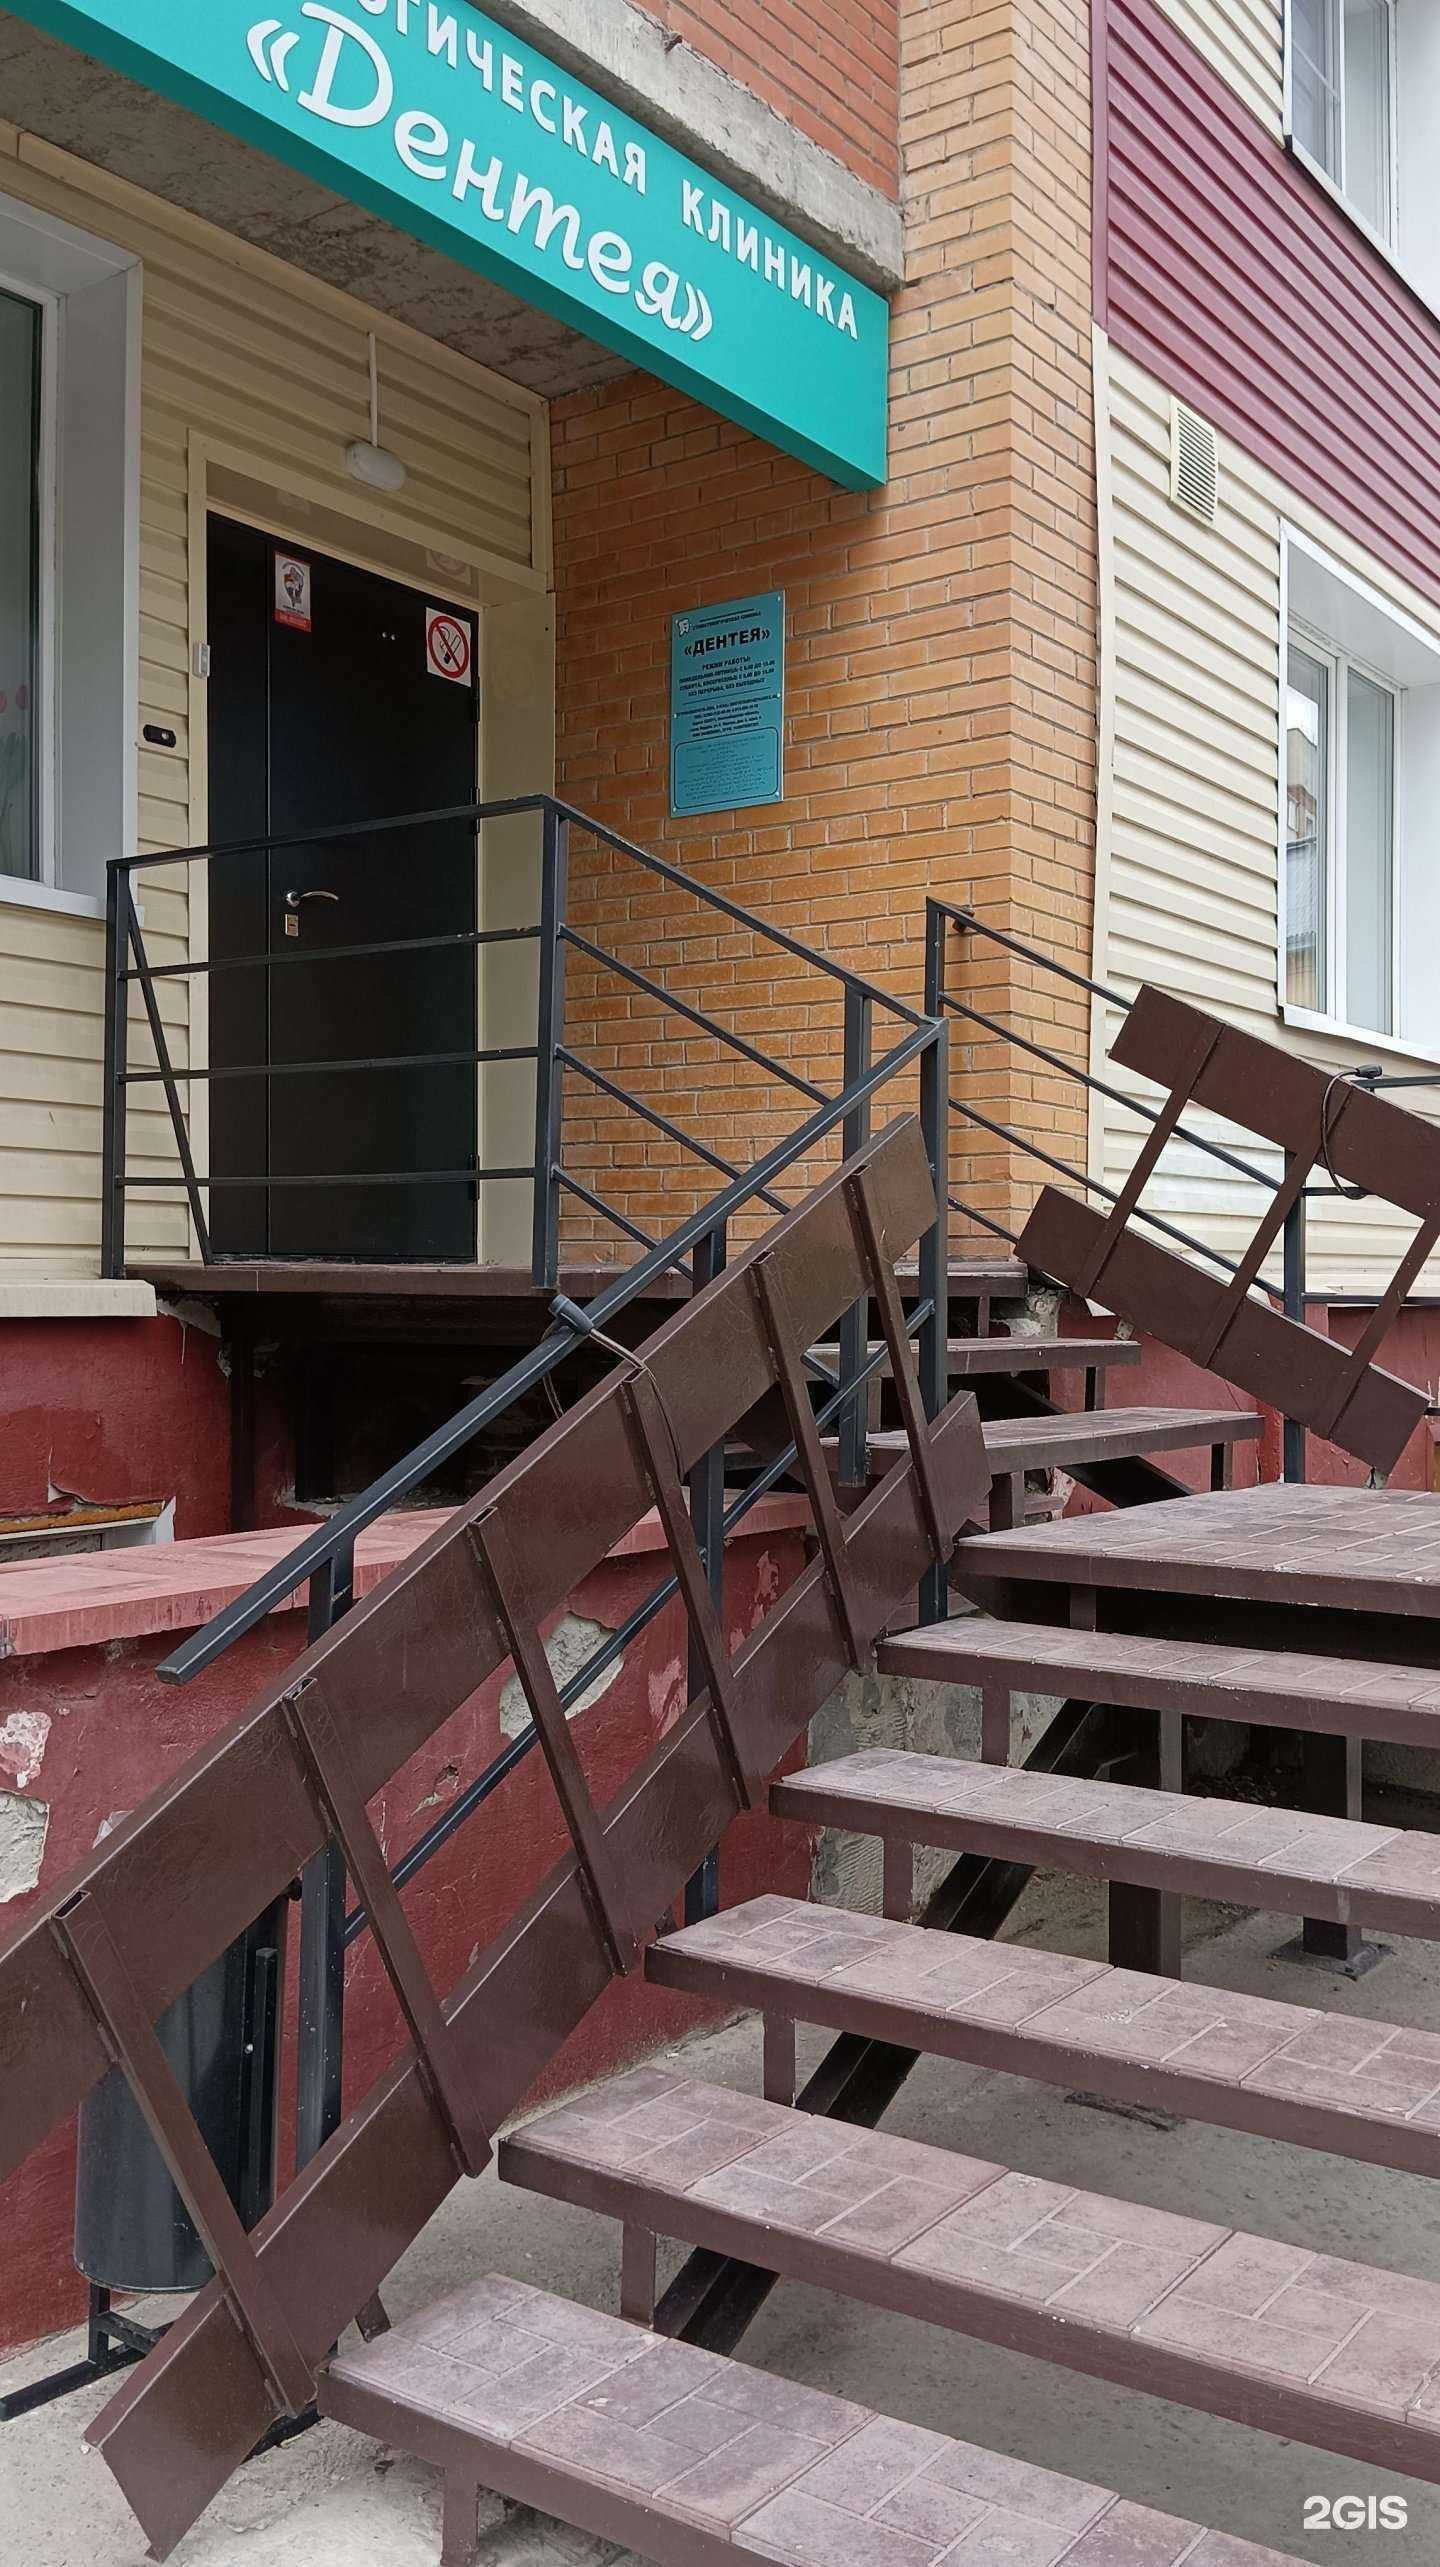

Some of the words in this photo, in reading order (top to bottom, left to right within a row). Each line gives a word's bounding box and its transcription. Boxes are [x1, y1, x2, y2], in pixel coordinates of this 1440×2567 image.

[357, 0, 646, 195] ГИЧЕСКАЯ
[681, 179, 859, 340] КЛИНИКА
[684, 627, 770, 657] «ДЕНТЕЯ»
